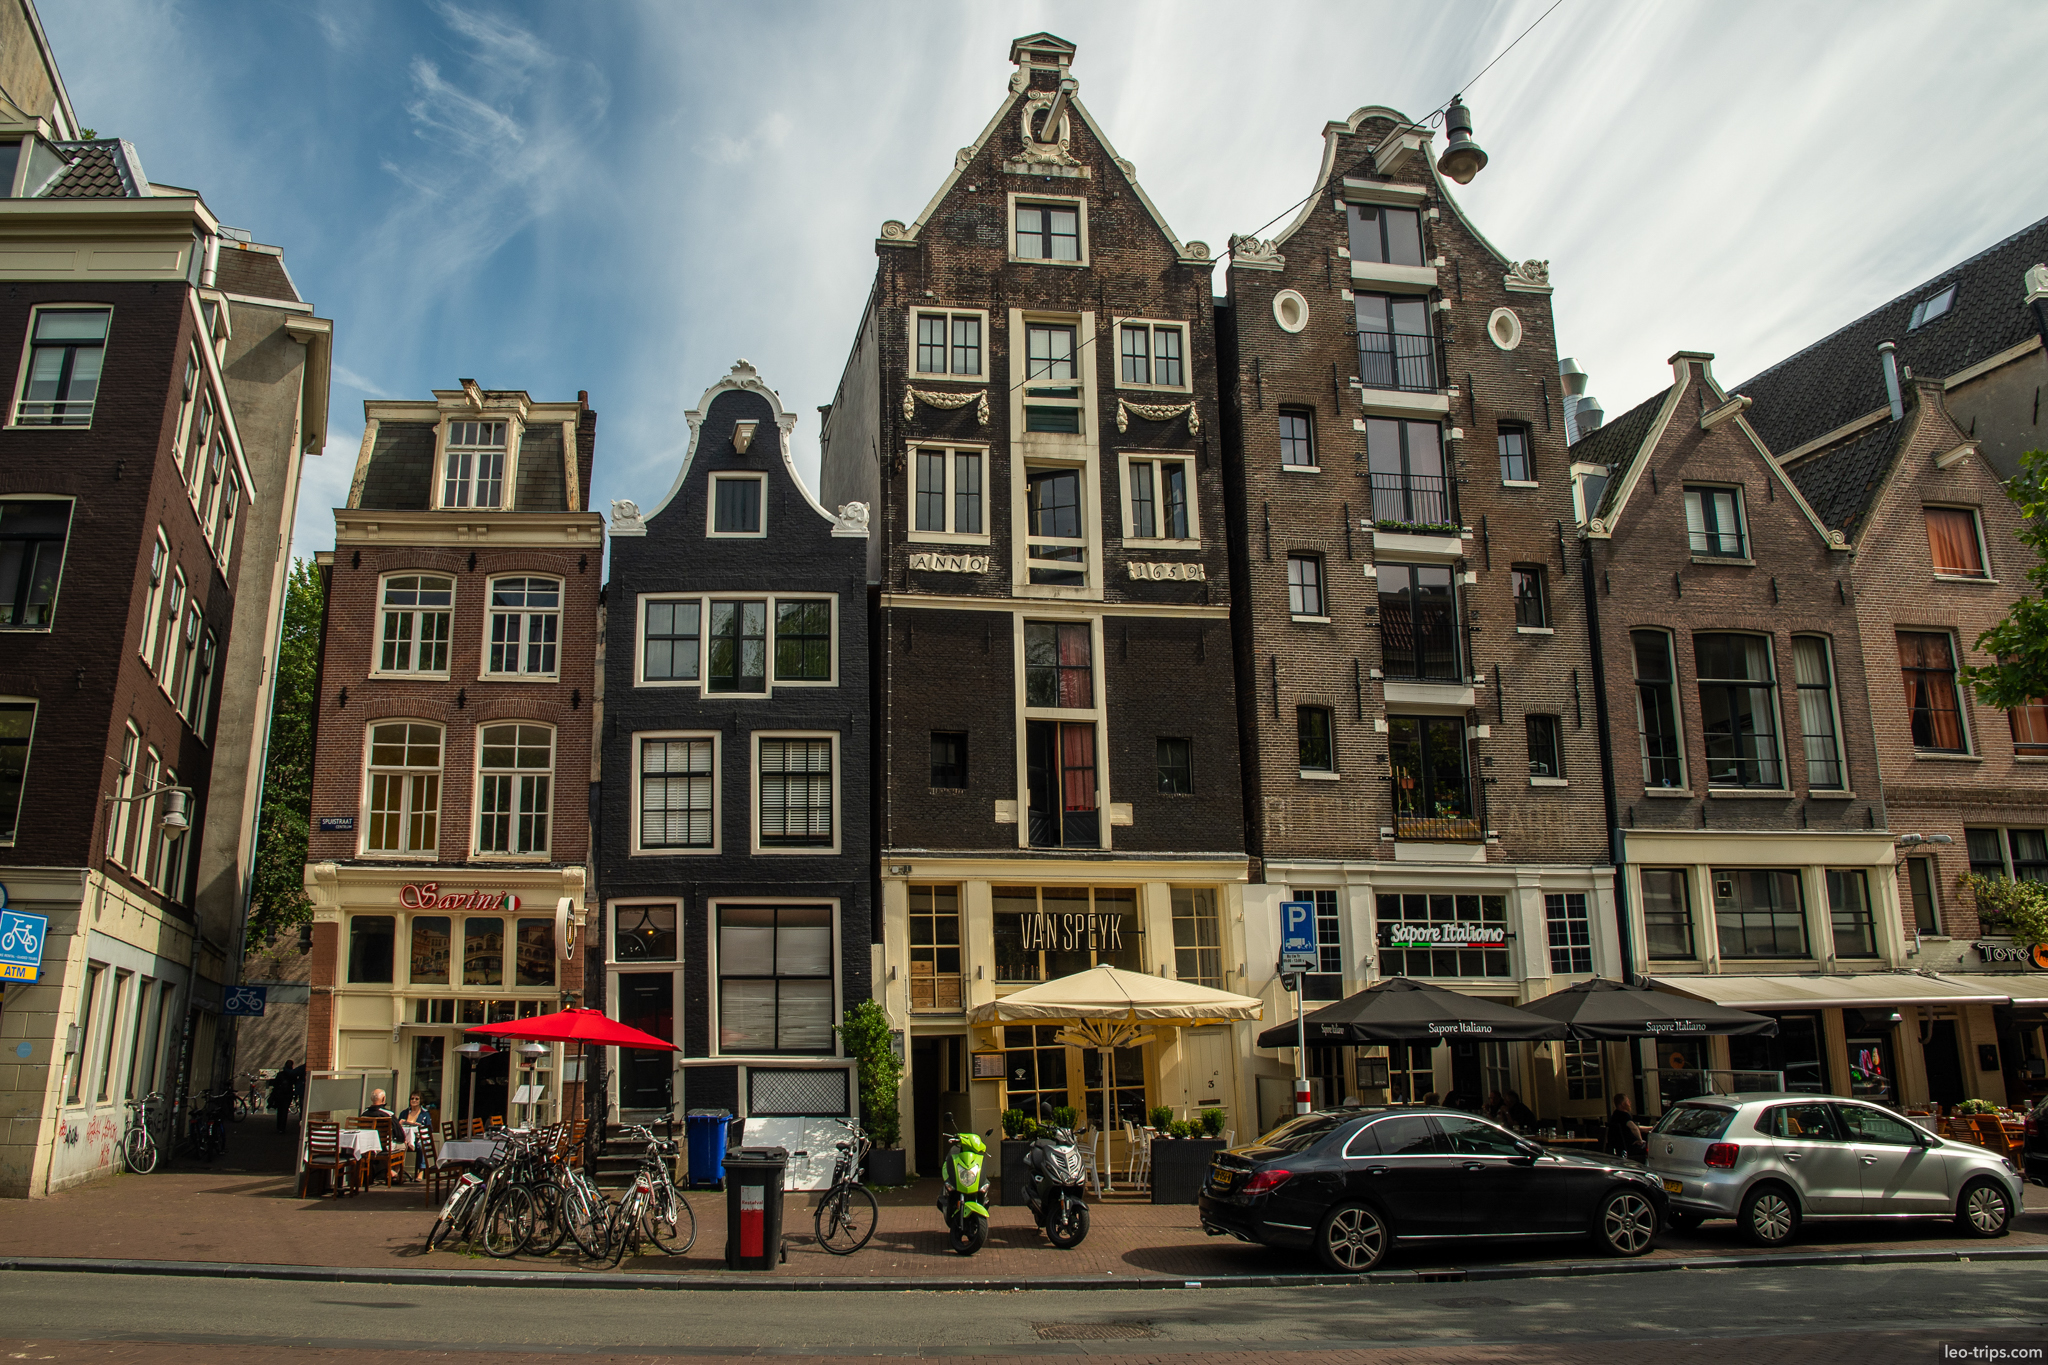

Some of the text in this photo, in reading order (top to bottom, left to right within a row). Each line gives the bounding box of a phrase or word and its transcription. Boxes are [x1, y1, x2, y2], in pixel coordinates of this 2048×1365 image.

[915, 556, 1197, 579] ANNO 1659
[399, 882, 507, 911] Savini
[1288, 907, 1306, 932] P
[1020, 913, 1123, 950] VAN SPEYK
[1391, 921, 1505, 948] Sapore Italiano
[1977, 943, 2030, 961] Toro
[4, 966, 26, 978] ATM
[1428, 1020, 1492, 1036] Sapore Italiano
[1646, 1019, 1707, 1034] Sapore Italiano
[1208, 1080, 1214, 1088] 3
